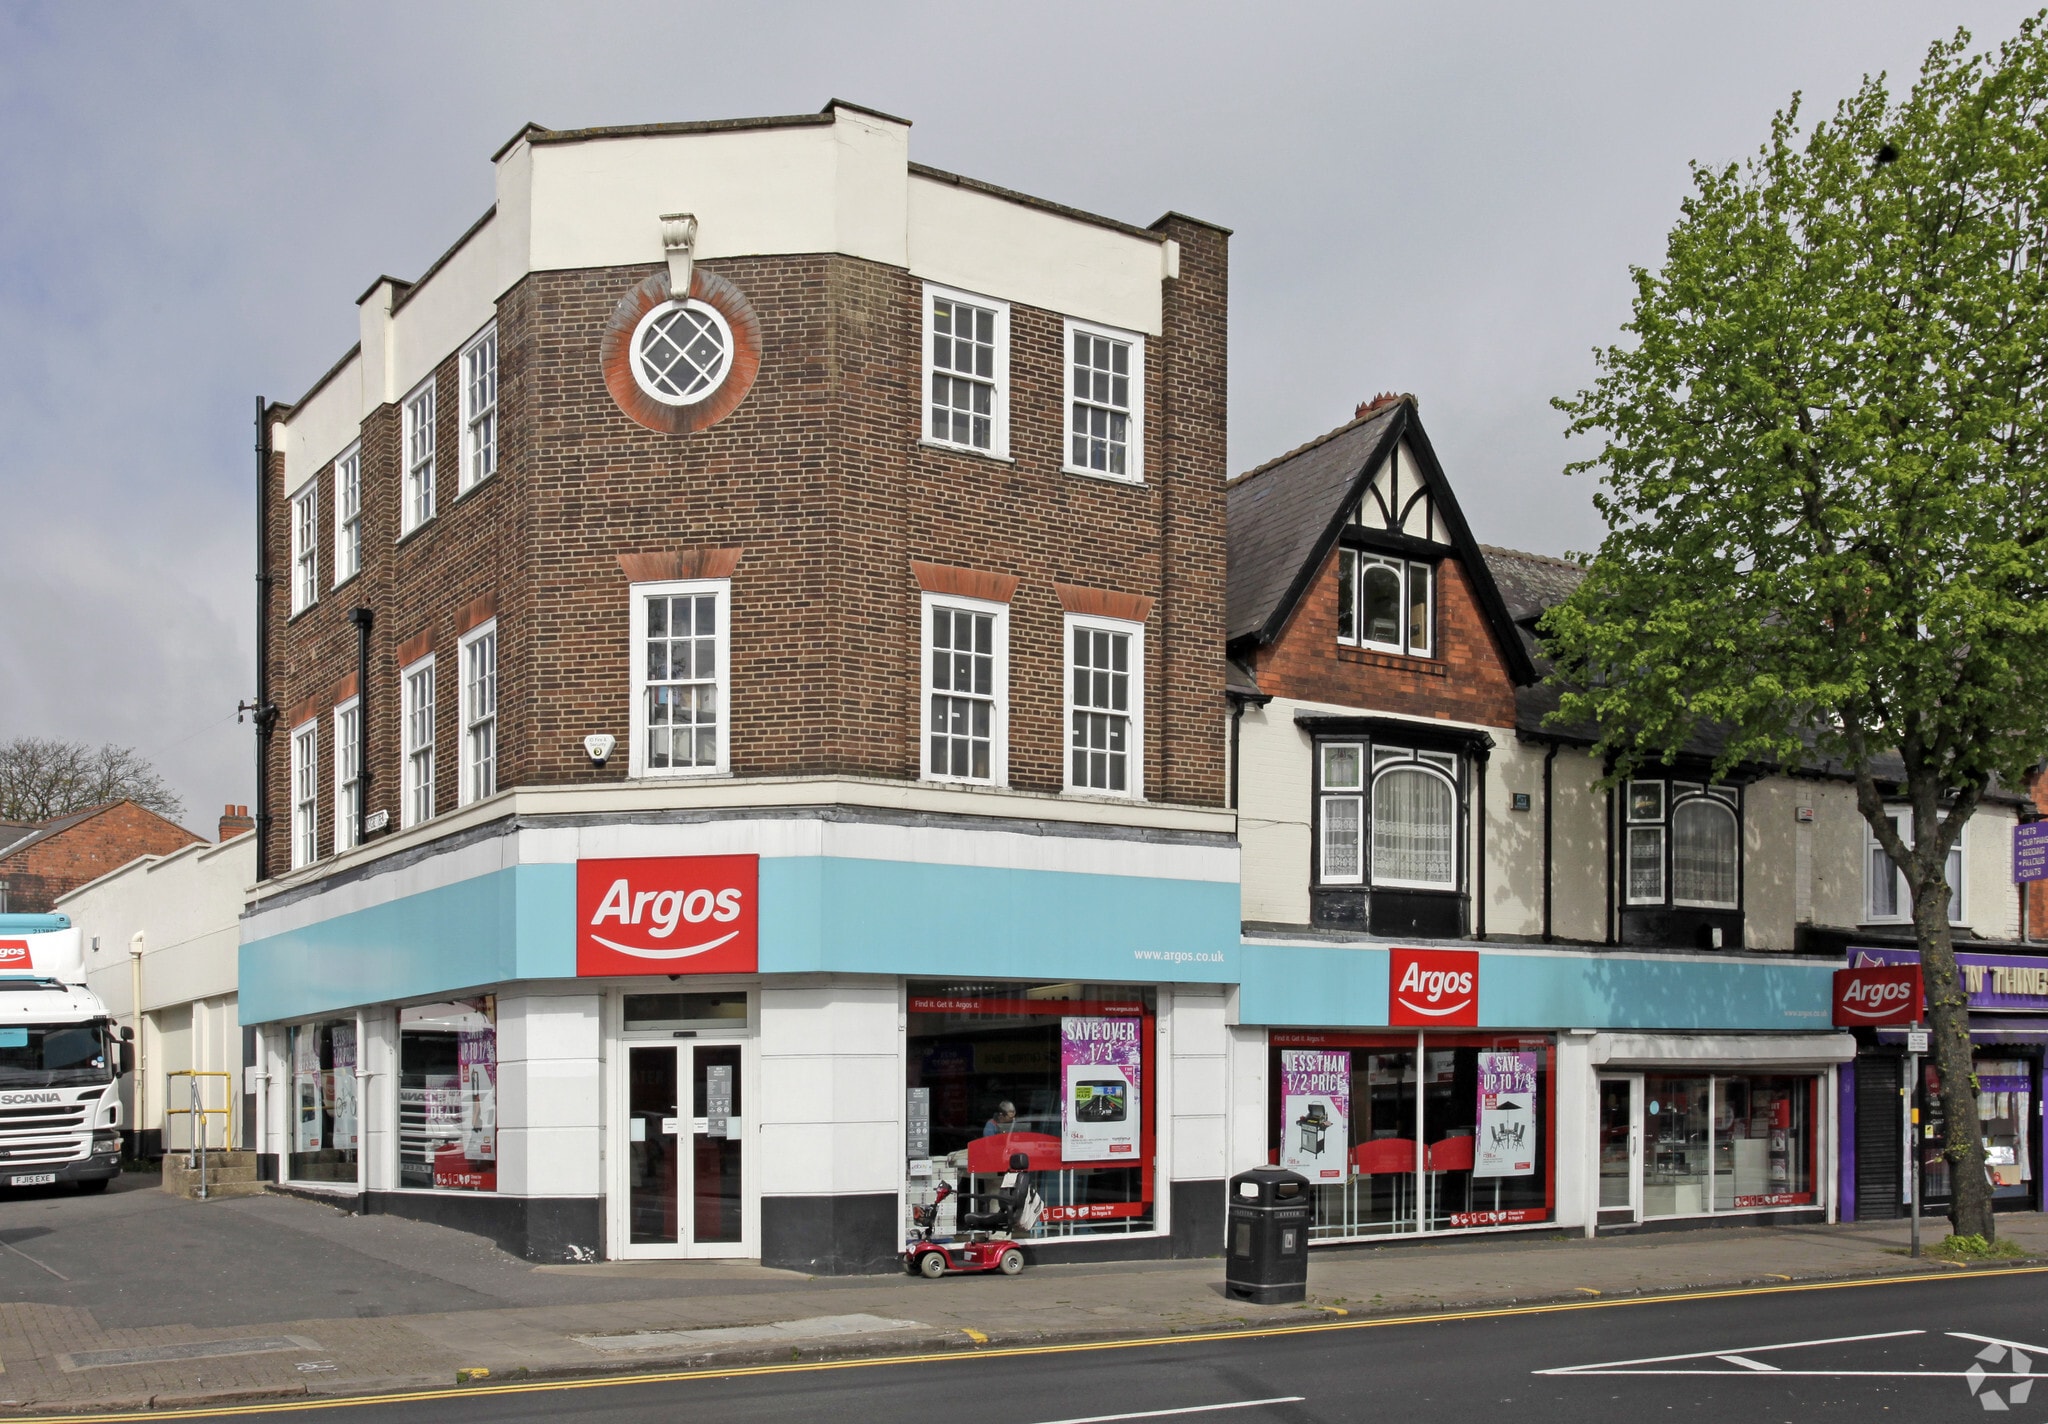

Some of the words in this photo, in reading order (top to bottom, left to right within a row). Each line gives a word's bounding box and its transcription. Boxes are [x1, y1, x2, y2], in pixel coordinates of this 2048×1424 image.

[2022, 826, 2037, 836] NETS
[2022, 846, 2045, 857] BEDDING
[2022, 856, 2045, 867] PILLOWS
[2022, 867, 2042, 878] QUILTS
[591, 878, 742, 938] Argos
[0, 947, 25, 958] gos
[1134, 950, 1225, 964] www.argos.co.uk
[1398, 961, 1473, 1002] Argos
[1989, 965, 2048, 995] THING
[1842, 979, 1911, 1008] Argos
[915, 1000, 929, 1008] Find
[937, 1000, 947, 1008] Get
[956, 1001, 973, 1010] Argos
[1067, 1022, 1099, 1041] SAVE
[1102, 1022, 1135, 1041] OVER
[1089, 1042, 1112, 1061] 1/3
[1286, 1053, 1314, 1072] LESS
[1317, 1054, 1345, 1072] THAN
[1496, 1055, 1520, 1072] SAVE
[1287, 1073, 1308, 1092] 1/2
[1311, 1073, 1344, 1091] PRICE
[1484, 1073, 1497, 1090] UP
[1500, 1073, 1512, 1090] TO
[1514, 1072, 1532, 1089] 1/3
[1, 1092, 61, 1105] SCANIA
[16, 1176, 34, 1184] FJ15
[36, 1174, 50, 1183] EXE
